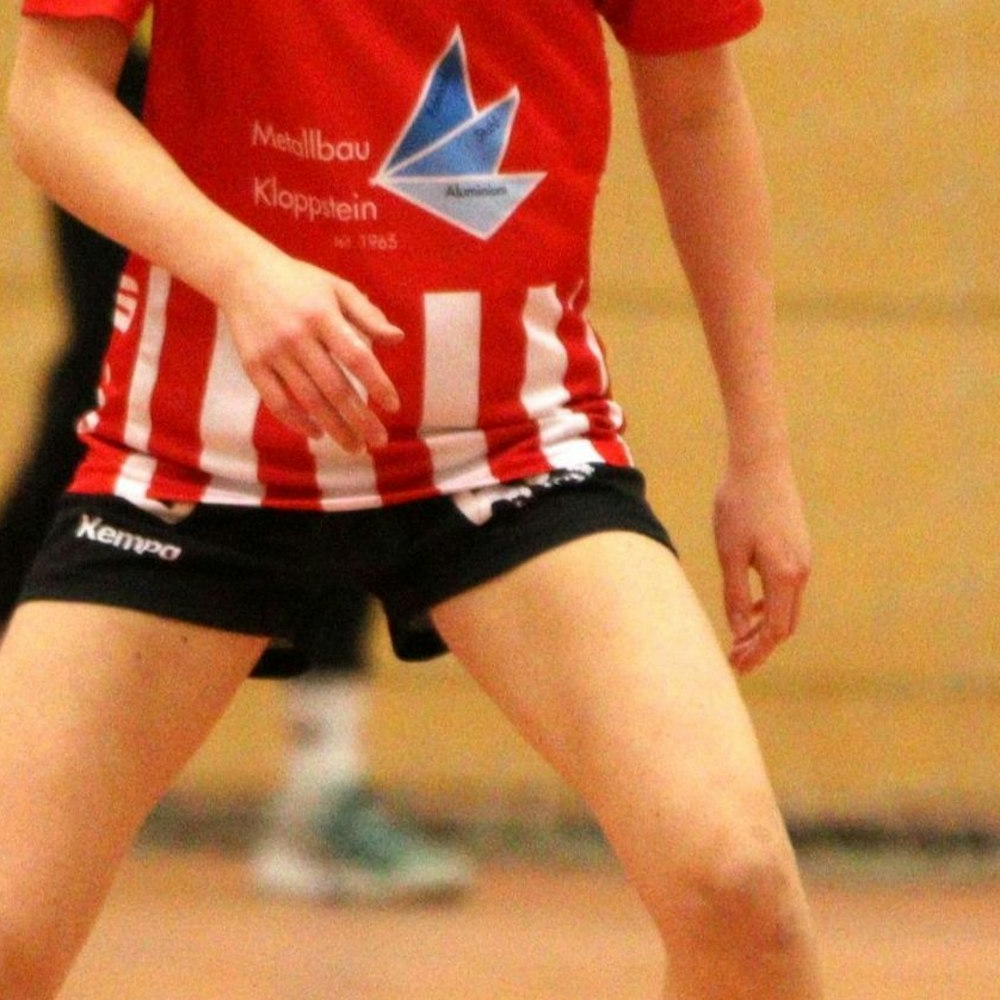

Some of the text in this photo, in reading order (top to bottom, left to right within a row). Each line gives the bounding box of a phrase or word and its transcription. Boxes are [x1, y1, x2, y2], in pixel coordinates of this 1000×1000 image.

[252, 120, 370, 162] Metallbau
[253, 176, 378, 222] Kloppstein
[75, 512, 182, 561] Kempa
